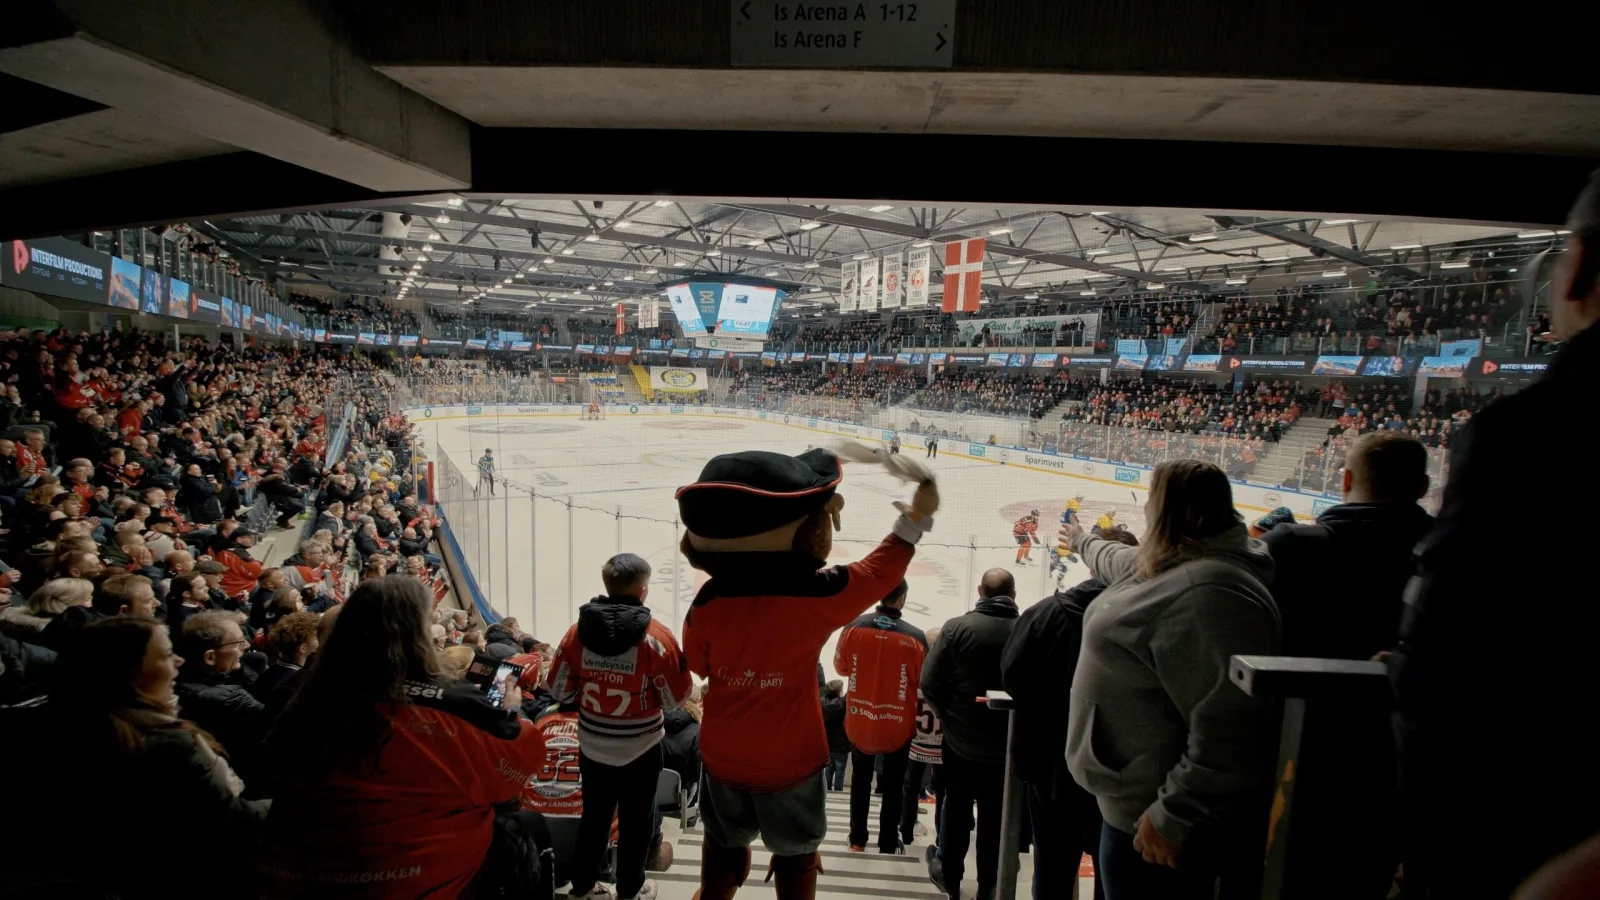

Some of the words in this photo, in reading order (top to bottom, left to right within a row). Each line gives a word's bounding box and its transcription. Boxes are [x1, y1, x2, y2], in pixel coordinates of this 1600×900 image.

[774, 3, 788, 21] Is
[793, 3, 848, 21] Arena
[853, 3, 866, 21] A
[879, 4, 917, 21] 1-12
[774, 30, 788, 48] Is
[793, 30, 847, 48] Arena
[853, 30, 862, 48] F
[31, 247, 65, 272] INTERFILM
[64, 257, 103, 281] PRODUCTIONS
[517, 406, 549, 414] Sparinvest
[1024, 454, 1065, 469] Sparinvest
[583, 657, 635, 673] Vendsyssel
[760, 677, 784, 689] BABY
[878, 712, 904, 723] Aalborg
